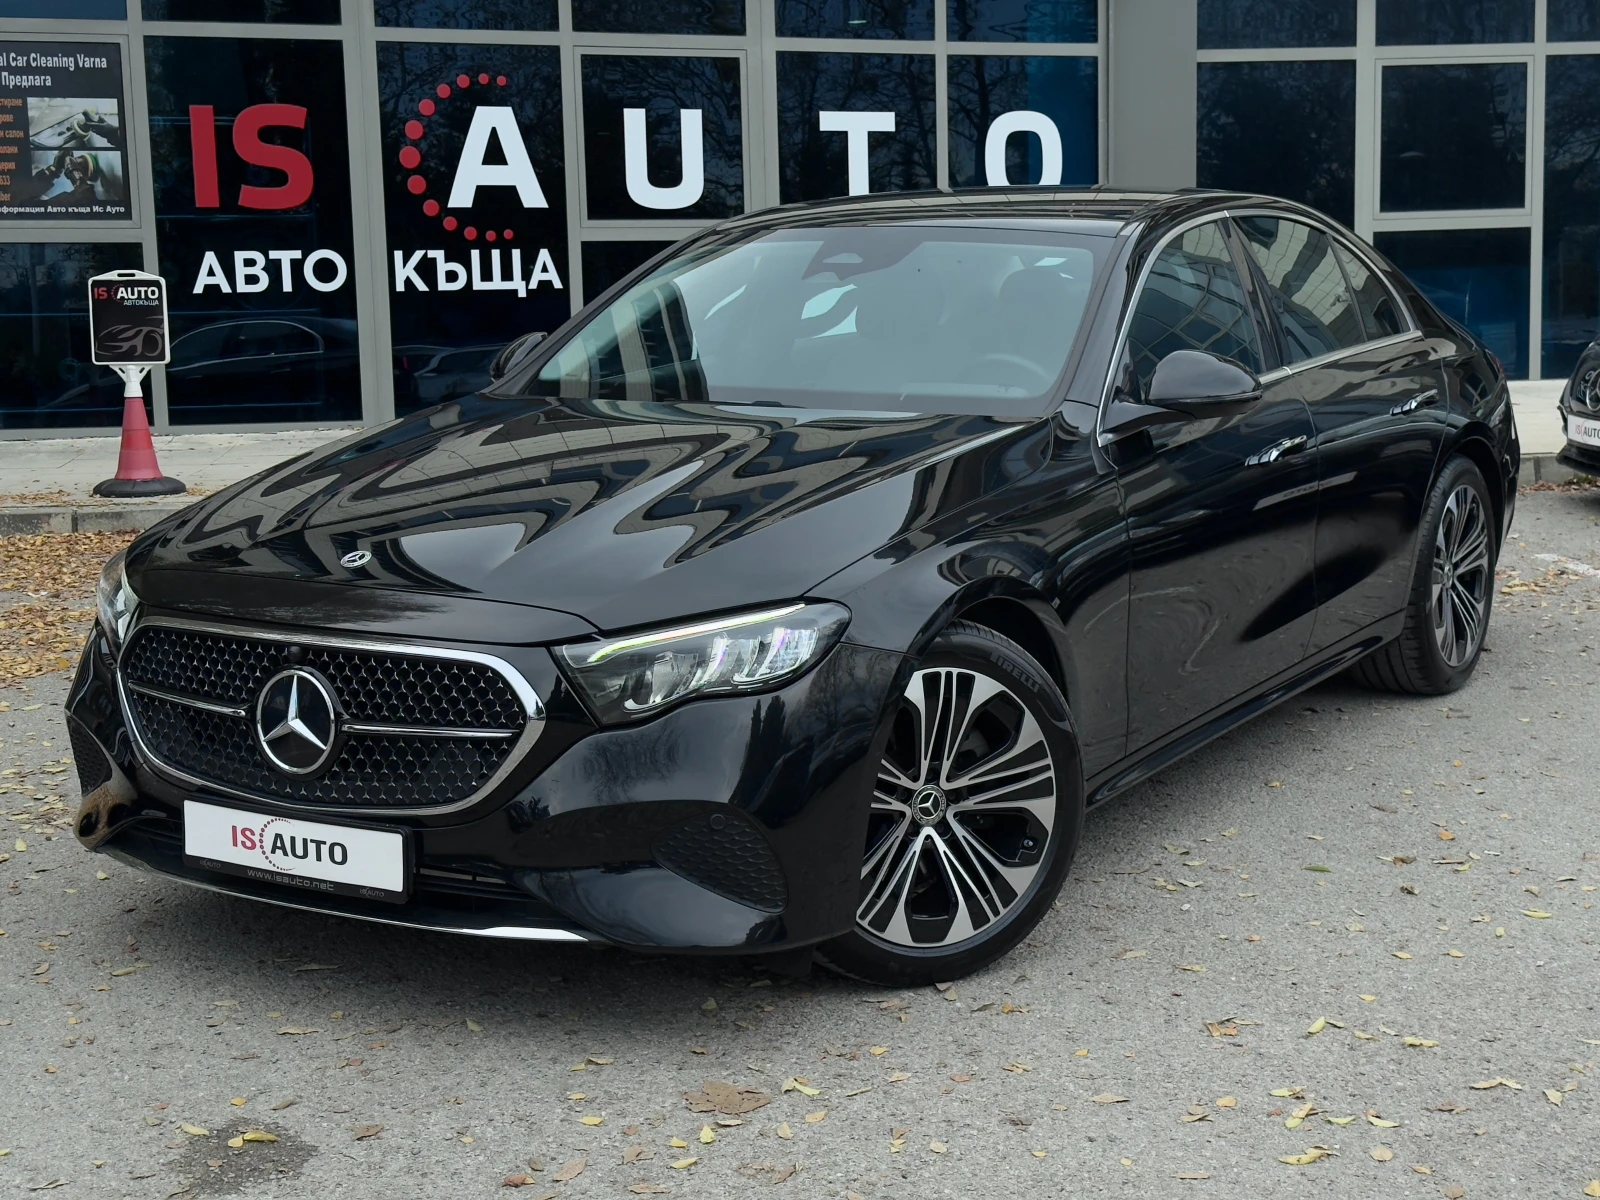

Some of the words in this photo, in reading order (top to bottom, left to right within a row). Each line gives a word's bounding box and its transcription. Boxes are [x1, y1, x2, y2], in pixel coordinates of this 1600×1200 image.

[9, 52, 28, 67] Car
[30, 53, 75, 71] Cleaning
[76, 53, 107, 68] Varna
[1, 71, 52, 89] Предлага
[5, 129, 24, 138] салон
[189, 103, 314, 210] IS
[0, 205, 45, 214] формация
[47, 205, 66, 213] Авто
[68, 206, 90, 214] къща
[93, 205, 104, 213] Ис
[106, 205, 125, 214] Ауто
[192, 249, 348, 294] АВТО
[395, 248, 563, 298] КЪЩА
[94, 287, 109, 300] IS
[116, 287, 159, 299] AUTO
[231, 825, 257, 851] IS
[270, 833, 348, 866] AUTO
[247, 869, 334, 892] www.isauto.net
